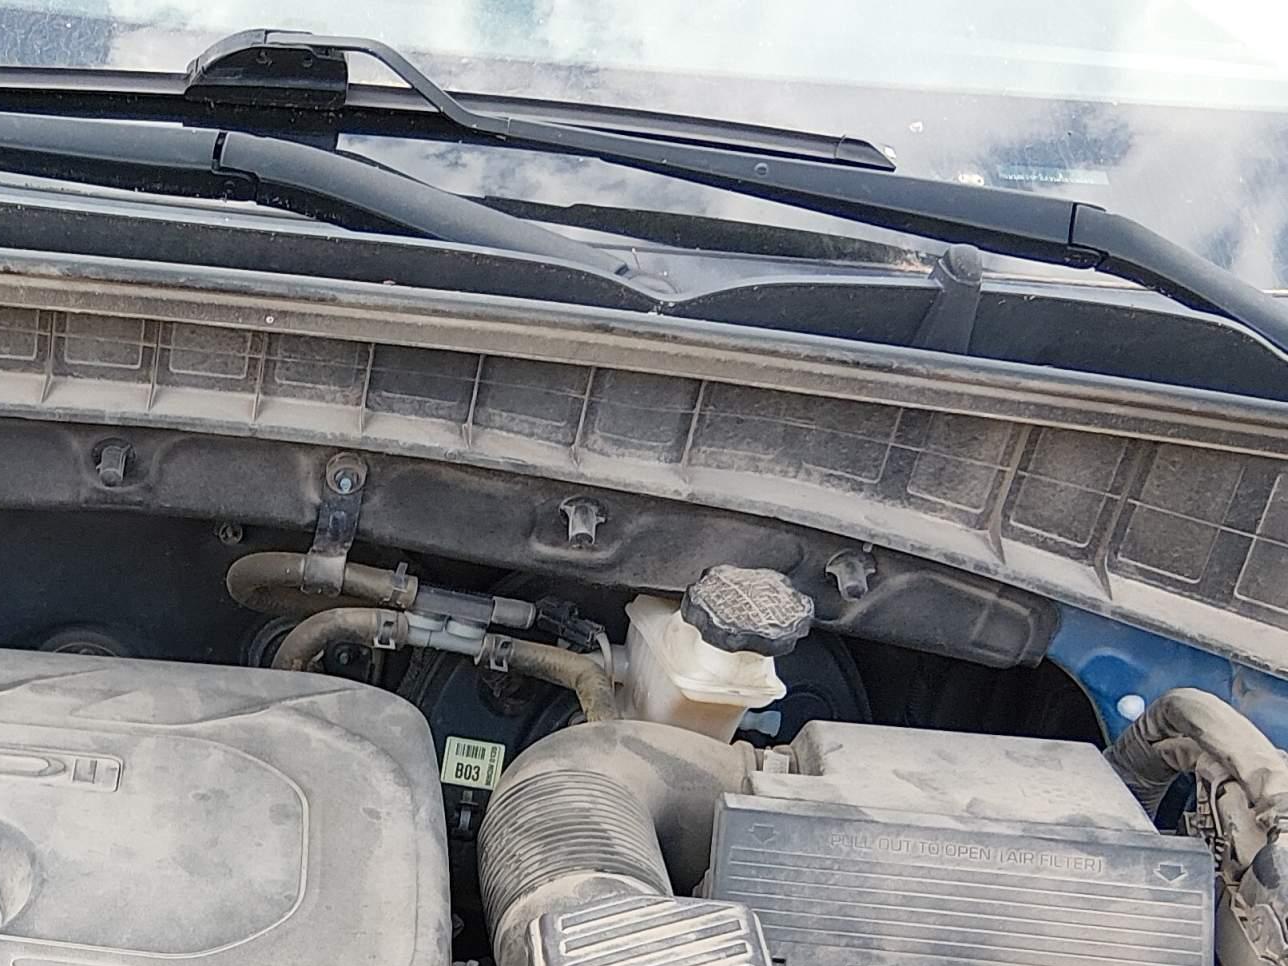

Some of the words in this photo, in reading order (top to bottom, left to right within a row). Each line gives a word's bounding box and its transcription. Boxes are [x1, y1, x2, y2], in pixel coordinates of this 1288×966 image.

[455, 762, 481, 782] B03
[831, 832, 872, 850] PULL
[878, 837, 912, 852] OUT
[919, 841, 940, 856] TO
[945, 843, 991, 861] OPEN
